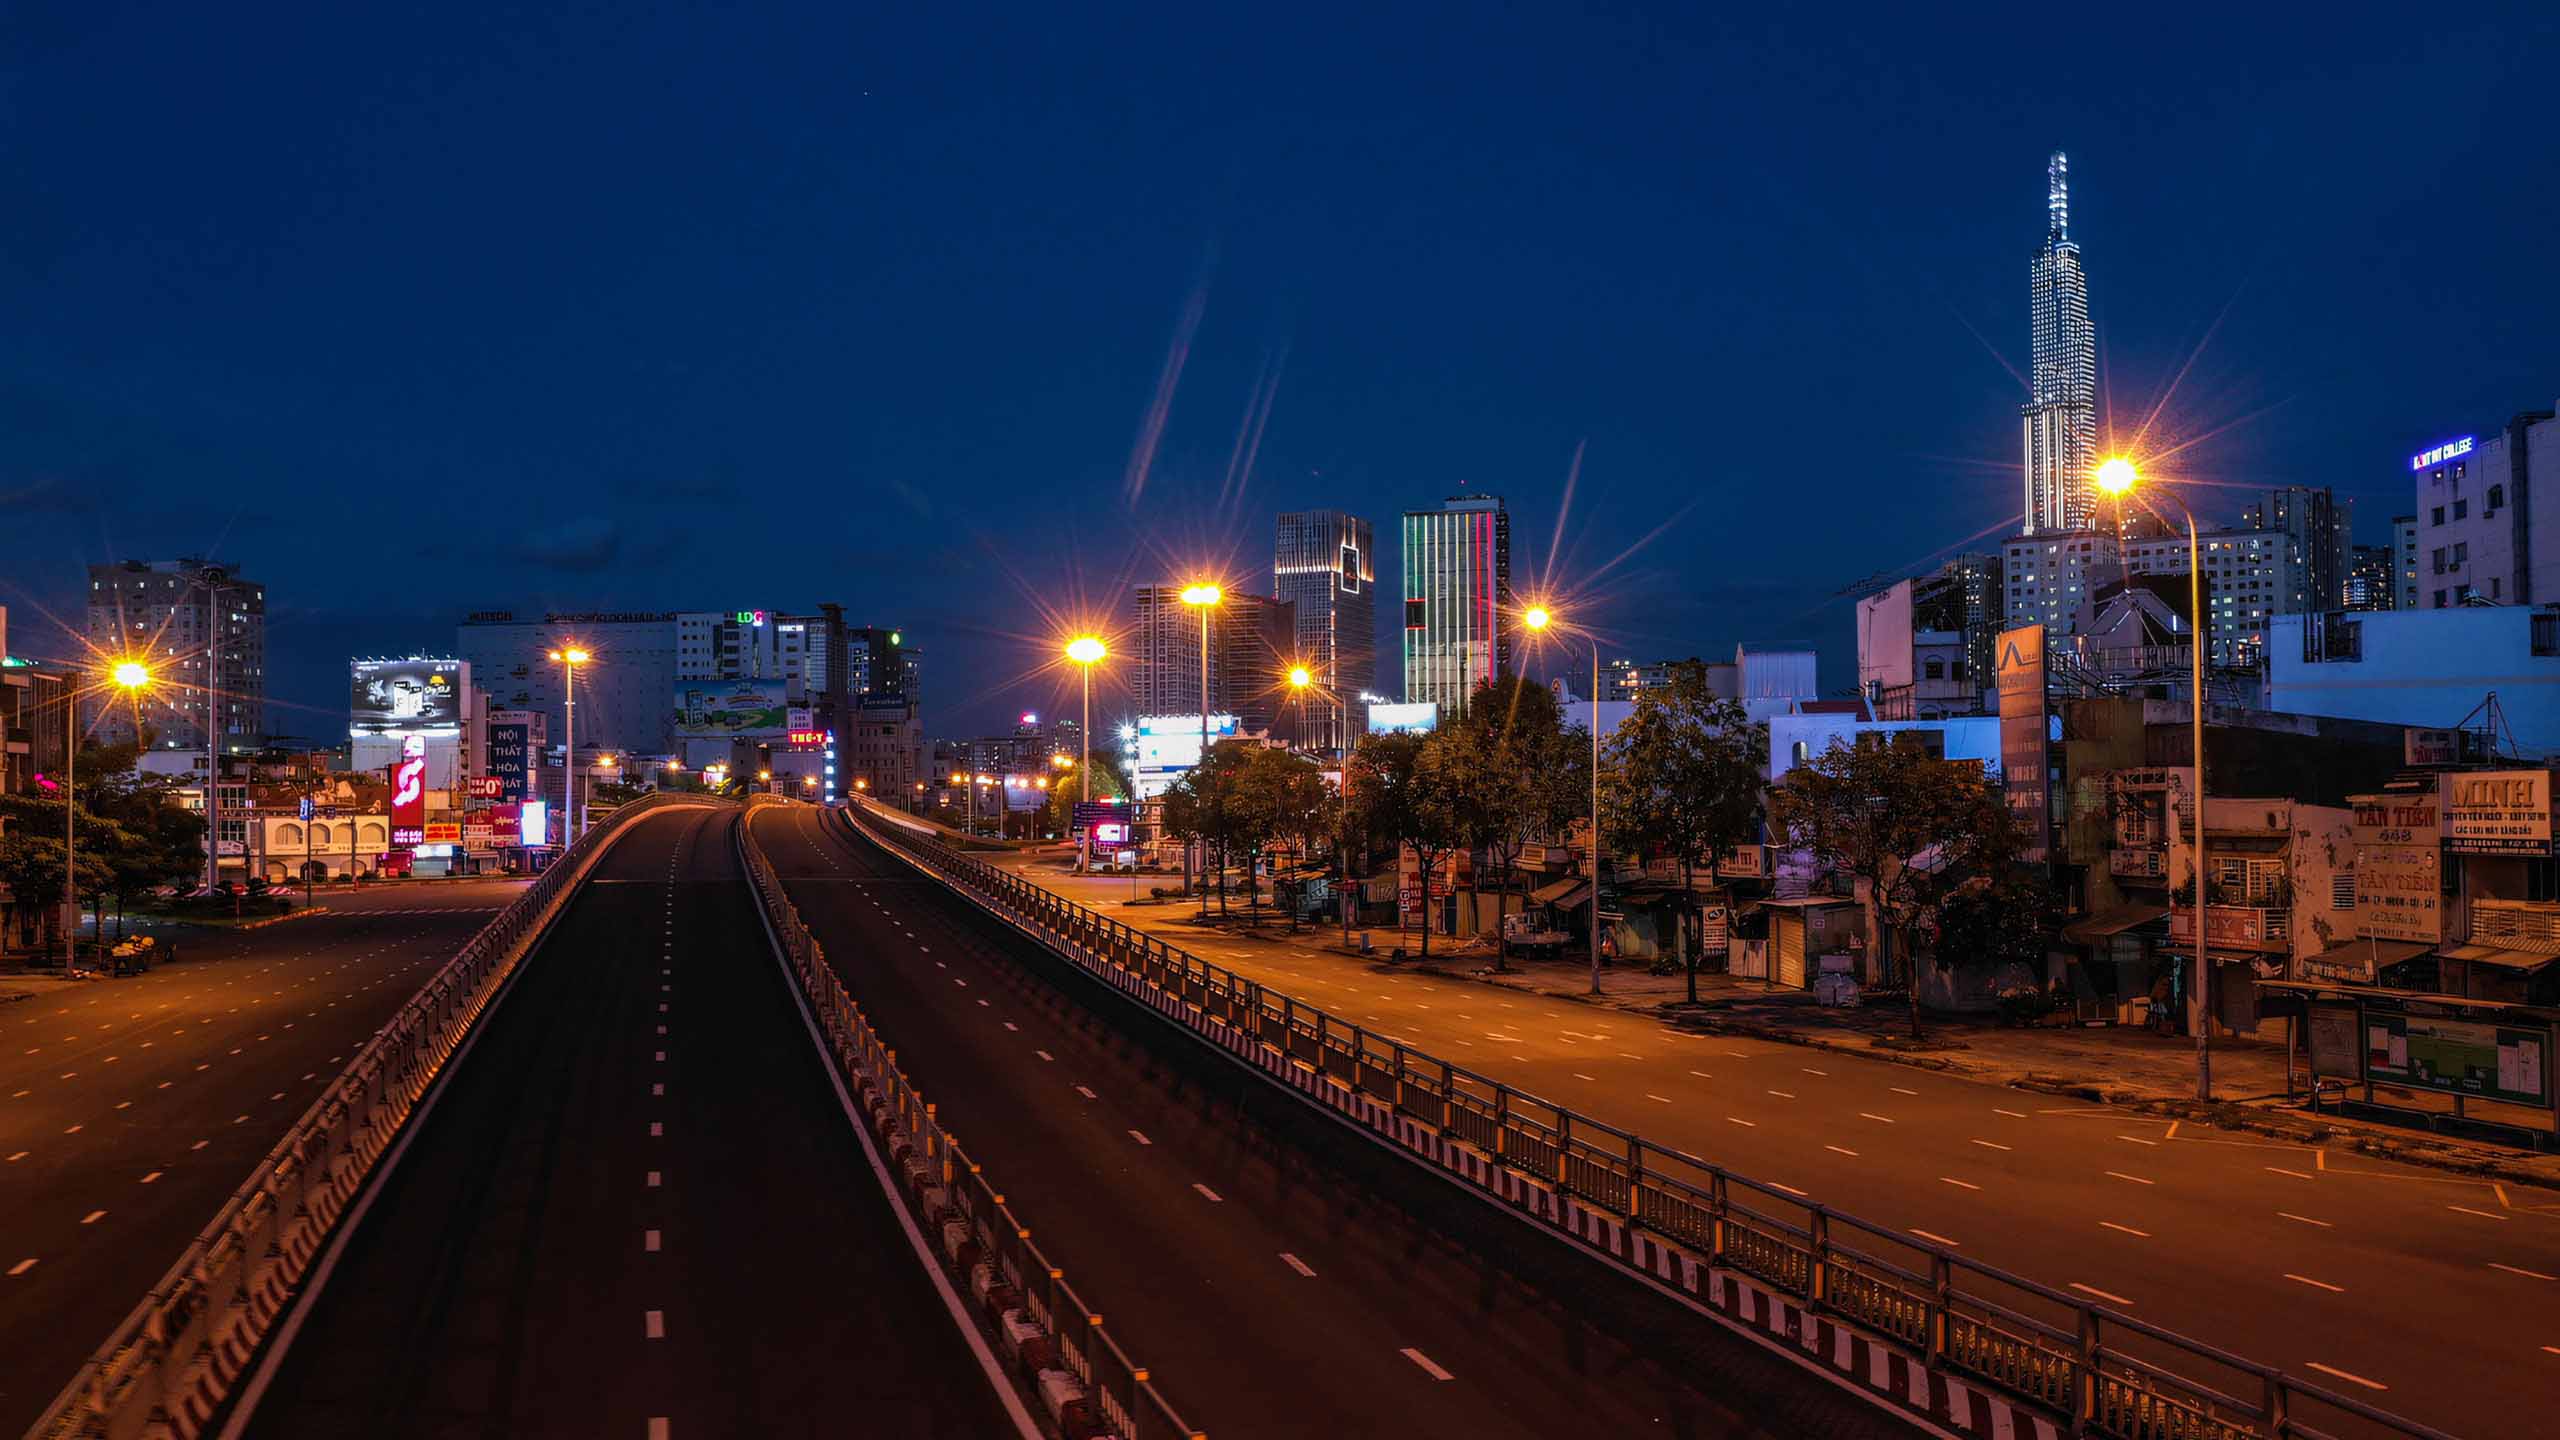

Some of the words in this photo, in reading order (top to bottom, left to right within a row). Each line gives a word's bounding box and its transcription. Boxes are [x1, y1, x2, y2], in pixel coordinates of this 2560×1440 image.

[737, 611, 763, 624] LDG
[498, 729, 519, 742] NỘI
[495, 744, 522, 757] THẤT
[496, 762, 520, 773] HÒA
[501, 777, 522, 790] HÁT
[2450, 779, 2535, 808] MINH
[2355, 803, 2388, 826] TÂN
[2393, 797, 2437, 827] TIẾN
